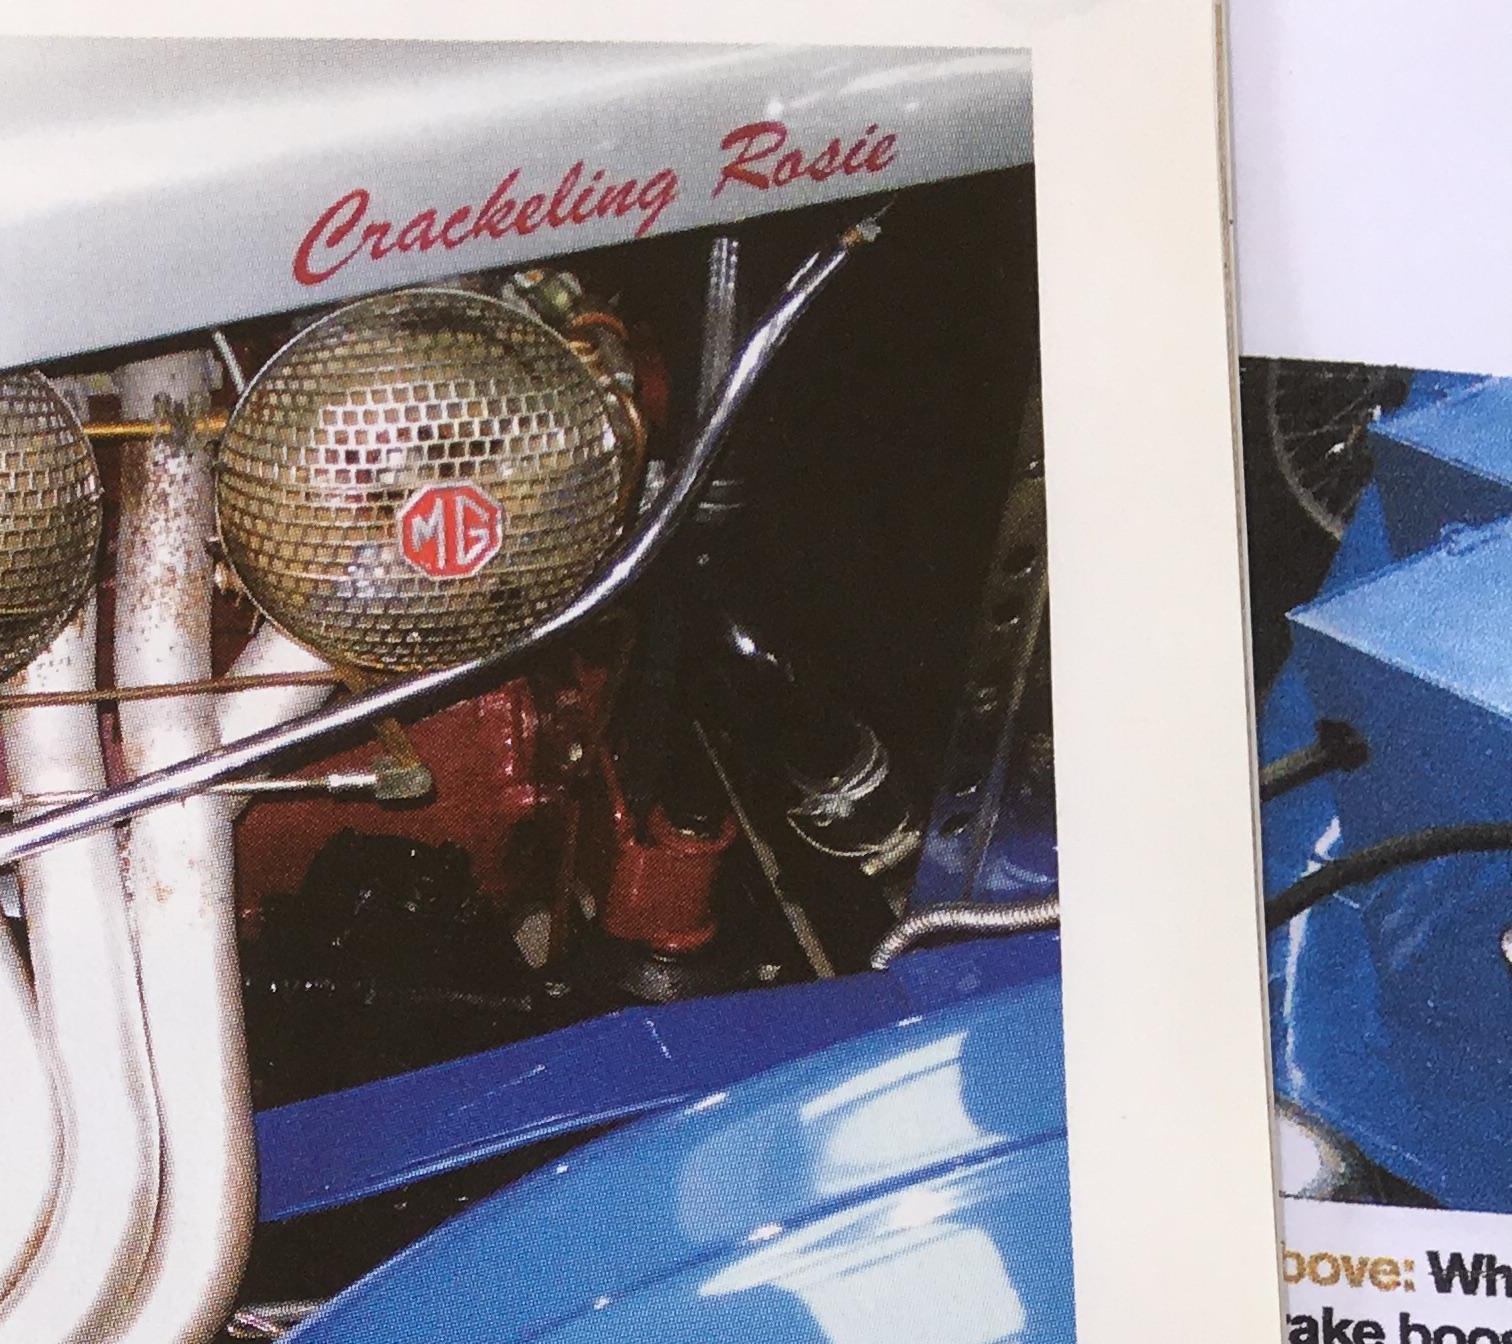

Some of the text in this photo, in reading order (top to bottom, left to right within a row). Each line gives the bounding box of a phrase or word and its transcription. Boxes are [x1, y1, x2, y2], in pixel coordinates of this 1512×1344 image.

[293, 120, 896, 286] Crackeling Rosie
[406, 494, 491, 570] MG
